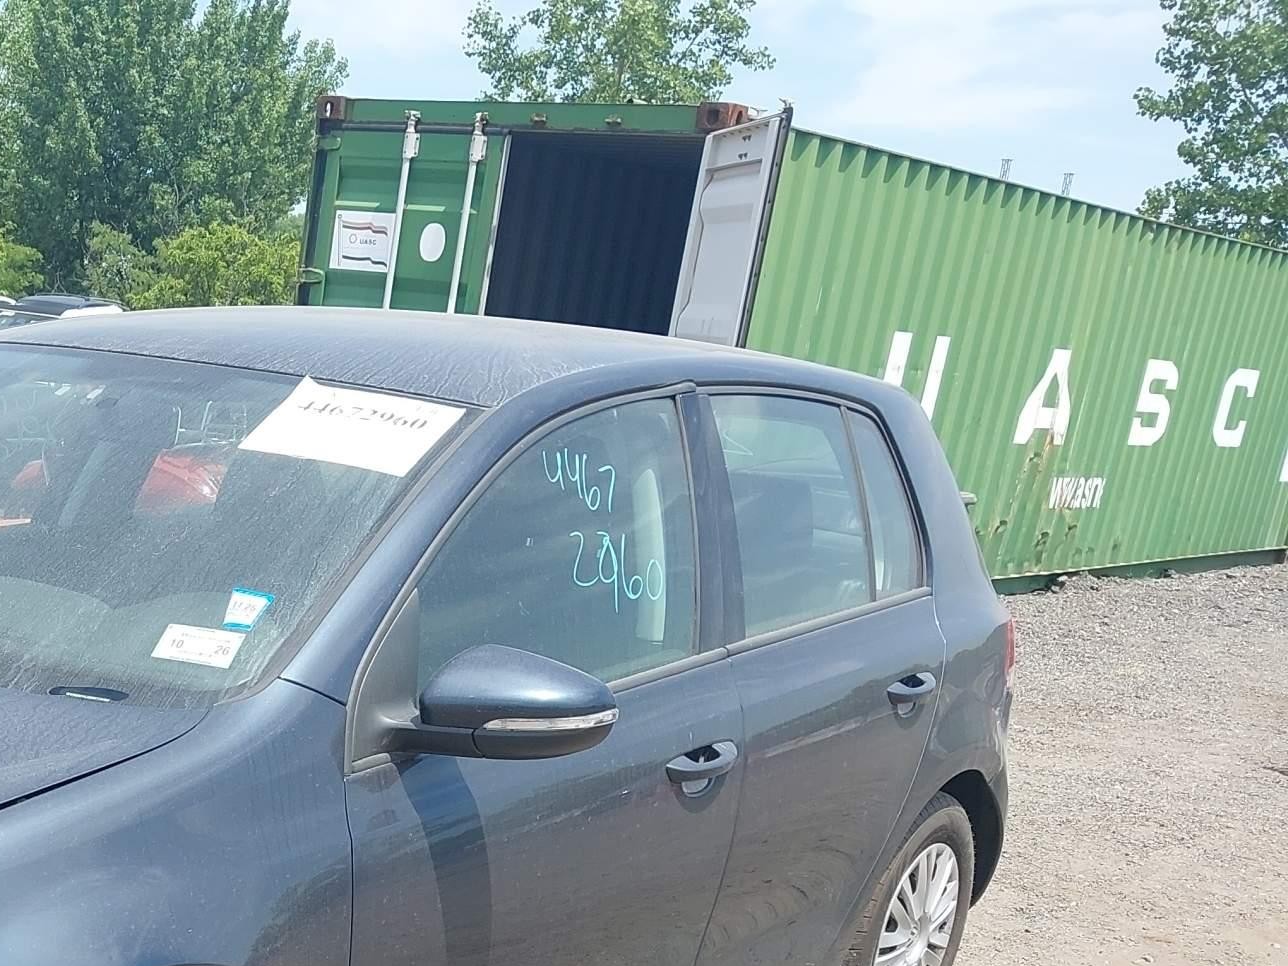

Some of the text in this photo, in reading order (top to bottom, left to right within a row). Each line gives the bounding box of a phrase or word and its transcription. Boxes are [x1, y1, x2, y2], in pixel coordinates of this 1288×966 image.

[543, 448, 615, 513] 4467
[569, 531, 663, 613] 2960
[169, 638, 184, 649] 10
